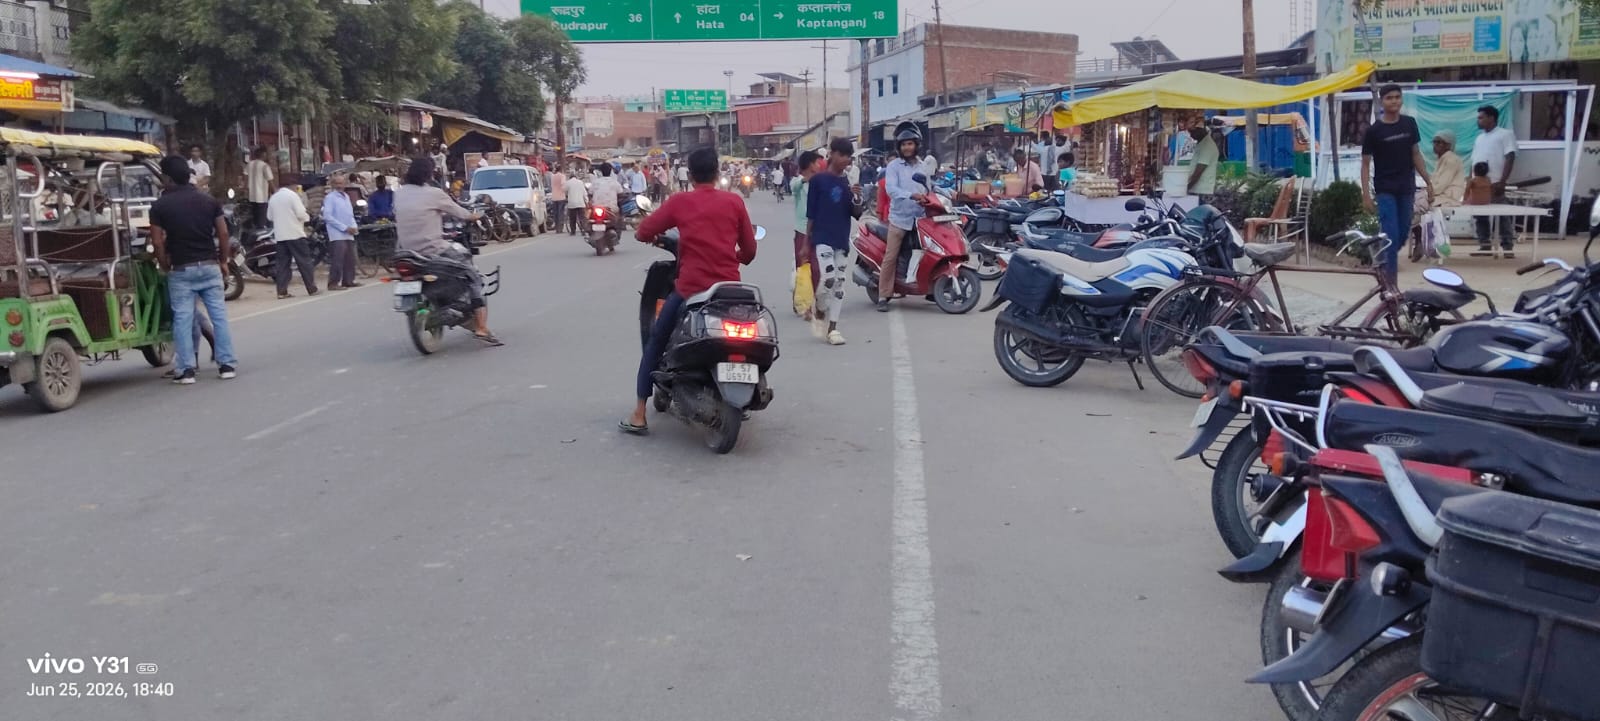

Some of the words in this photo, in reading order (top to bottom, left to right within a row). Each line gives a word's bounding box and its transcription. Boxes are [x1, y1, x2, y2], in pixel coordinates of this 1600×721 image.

[628, 13, 643, 23] 36
[739, 12, 755, 22] 04
[872, 11, 885, 20] 18
[696, 20, 725, 29] Hata
[796, 18, 867, 29] Kaptanganj
